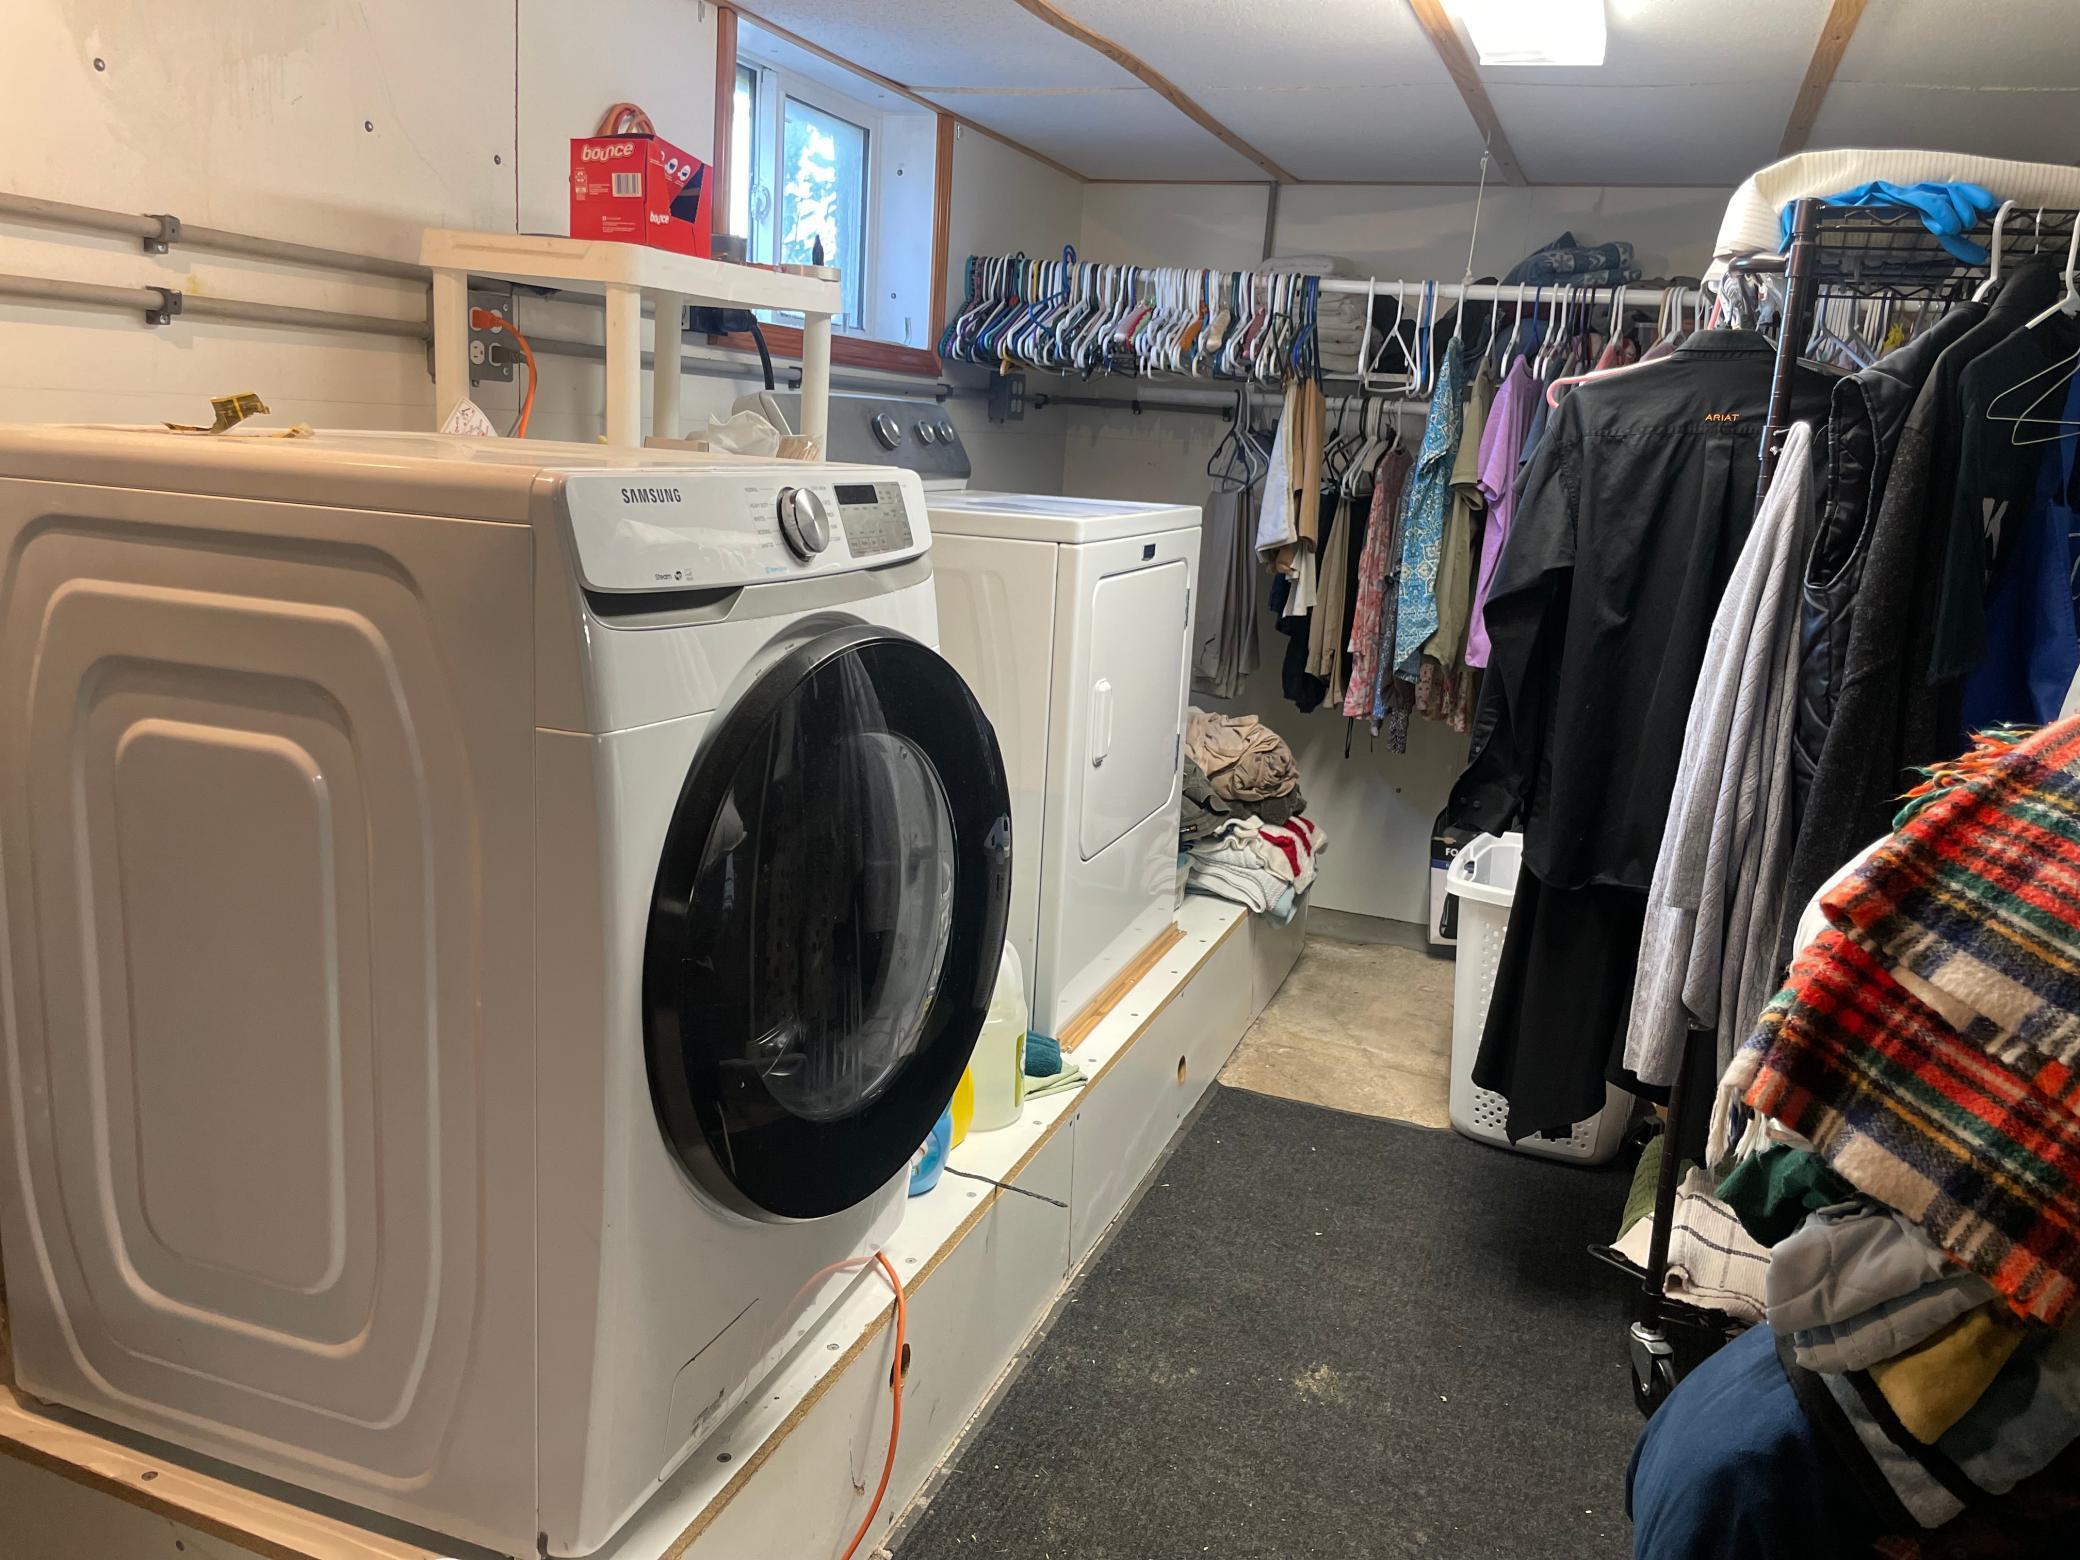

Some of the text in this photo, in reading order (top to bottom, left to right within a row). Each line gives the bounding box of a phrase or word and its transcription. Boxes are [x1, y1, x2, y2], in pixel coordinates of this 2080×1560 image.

[582, 143, 633, 161] bounce
[650, 211, 669, 224] bounce
[621, 488, 681, 503] SAMSUNG
